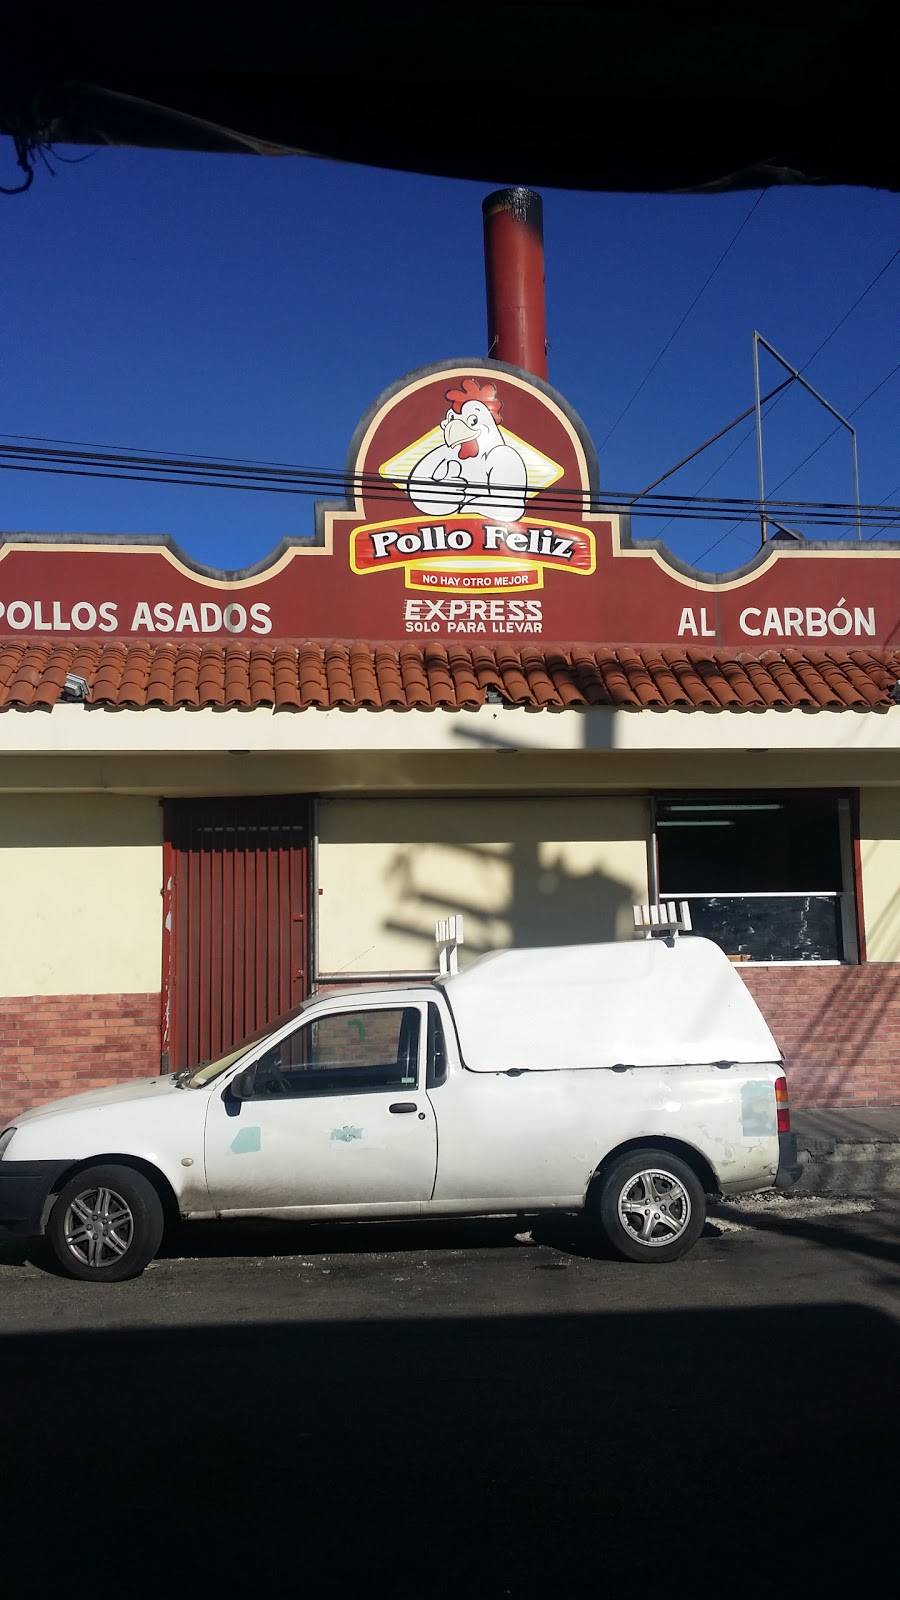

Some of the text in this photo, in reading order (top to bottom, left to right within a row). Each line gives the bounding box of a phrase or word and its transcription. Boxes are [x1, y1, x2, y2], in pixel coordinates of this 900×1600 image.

[371, 525, 576, 559] Pollo Feliz
[422, 575, 529, 587] NO HAY OTRO MEJOR
[0, 600, 273, 634] OLLOS ASADOS
[404, 600, 543, 620] EXPRESS
[677, 597, 876, 636] AL CARBÓN
[405, 621, 543, 633] SOLO PARA LLEVAR
